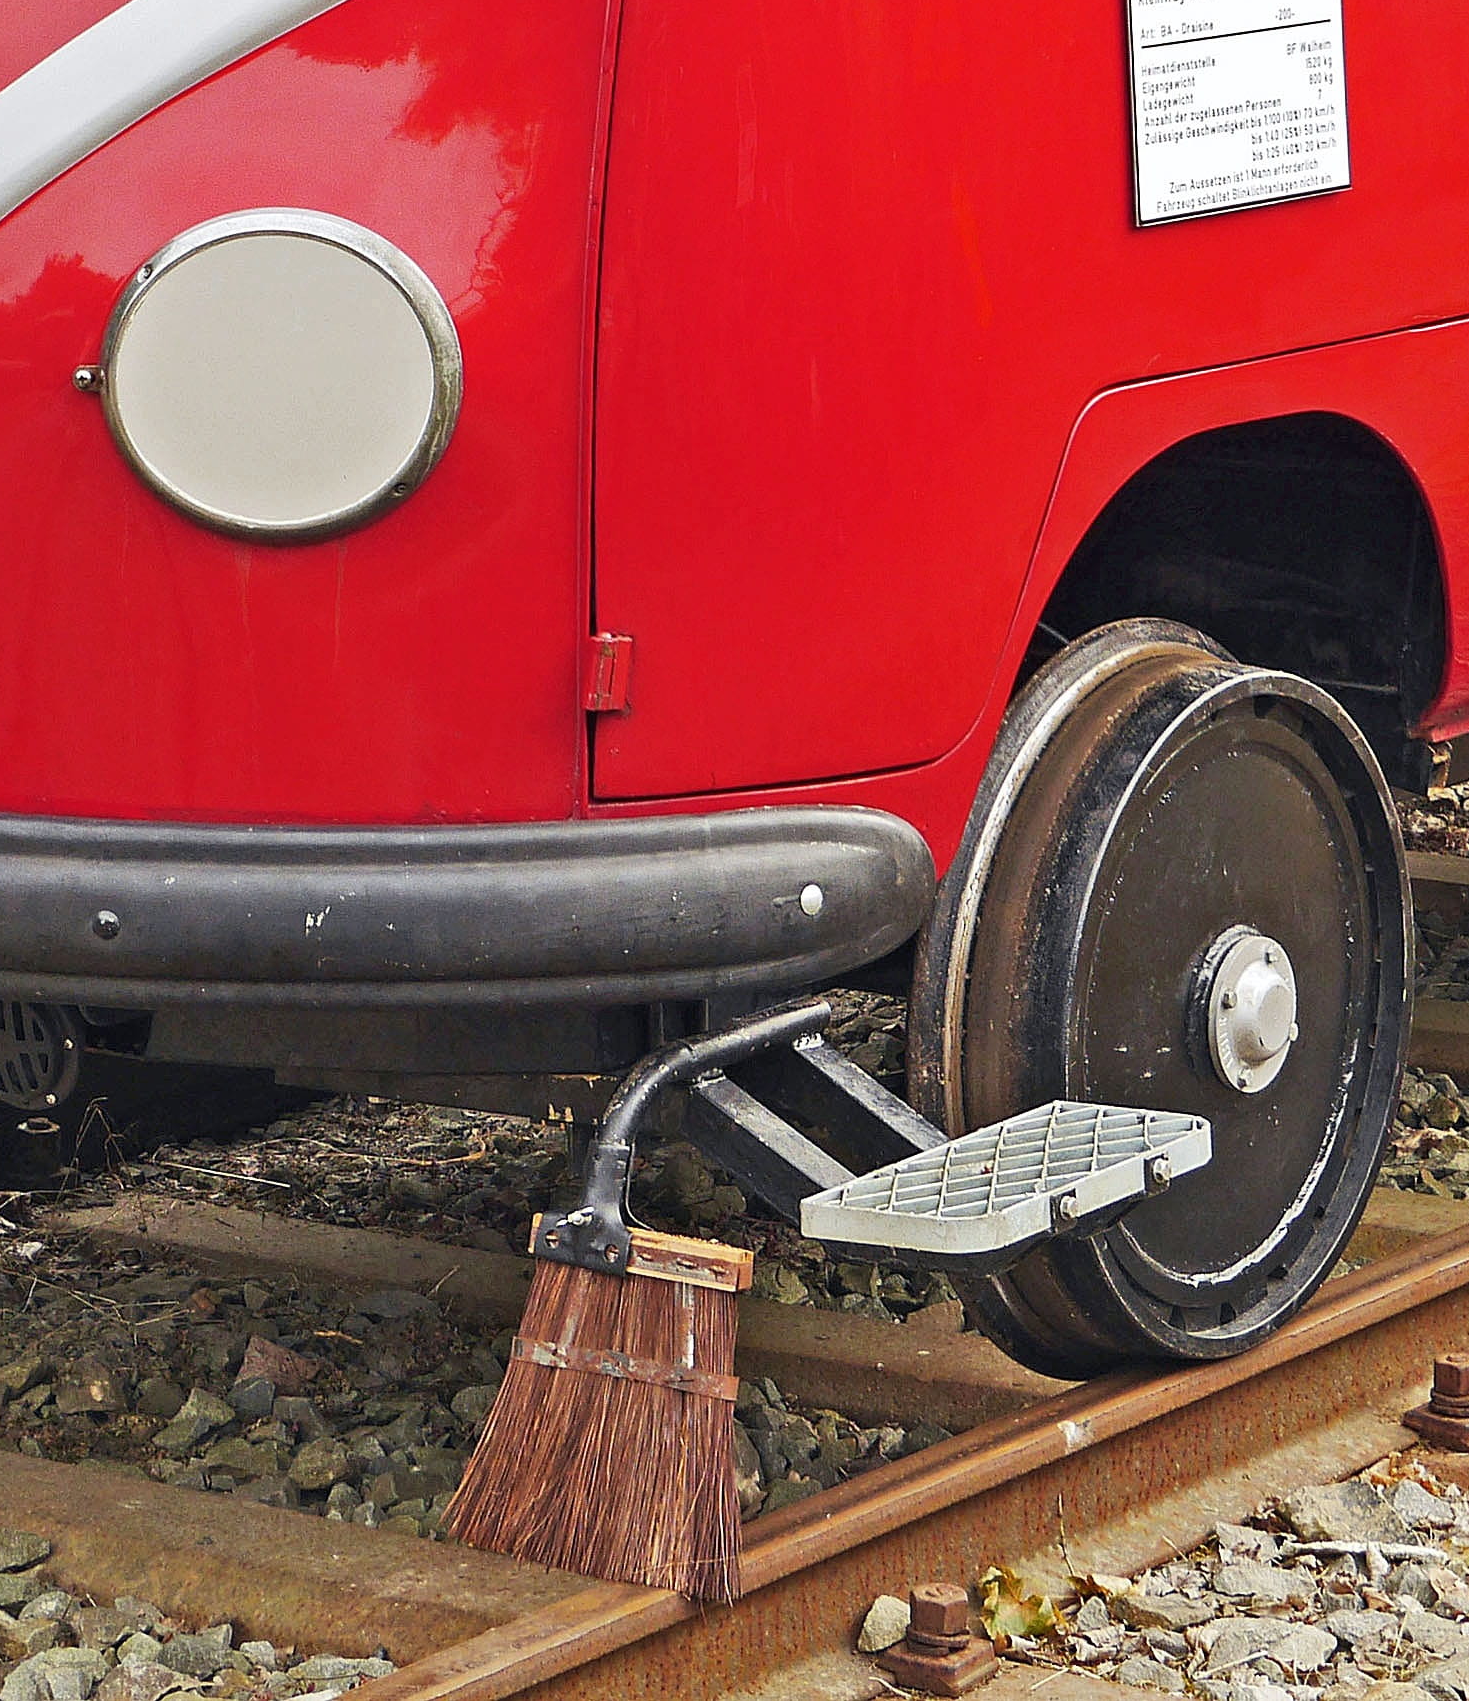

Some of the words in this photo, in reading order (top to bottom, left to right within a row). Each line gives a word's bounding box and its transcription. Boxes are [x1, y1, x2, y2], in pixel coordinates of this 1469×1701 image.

[1245, 99, 1281, 113] Personen
[1169, 181, 1187, 194] Zum
[1190, 175, 1231, 190] Aussetzen
